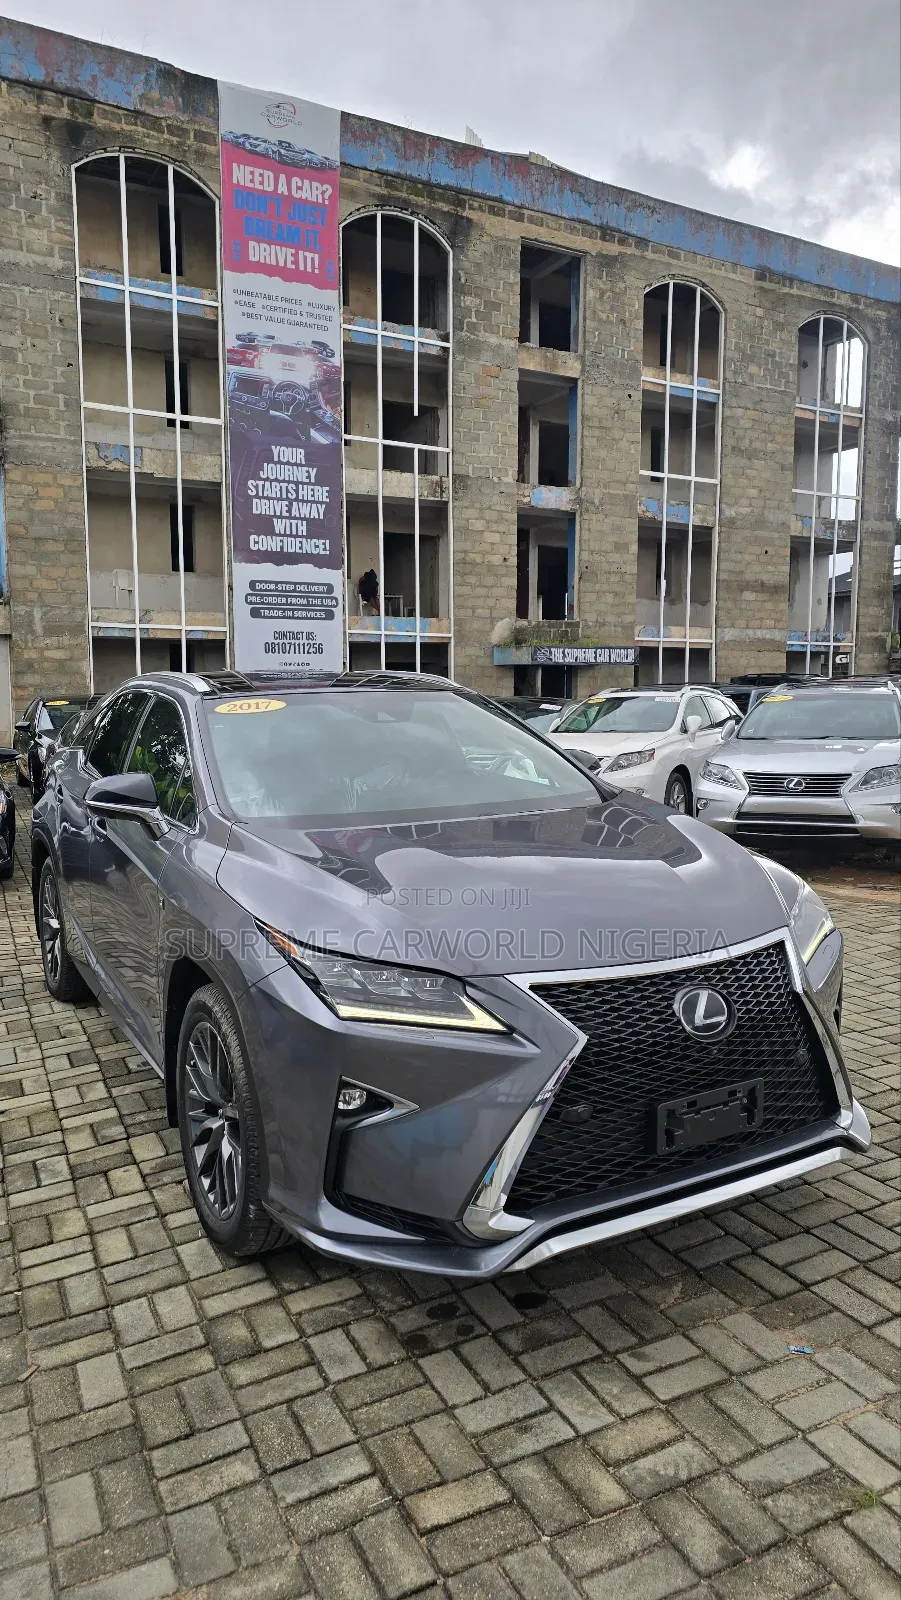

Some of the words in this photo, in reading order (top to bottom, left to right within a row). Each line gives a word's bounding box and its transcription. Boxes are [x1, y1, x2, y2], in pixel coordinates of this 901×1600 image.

[232, 163, 274, 191] NEED
[277, 174, 288, 195] A
[291, 177, 332, 204] CAR?
[234, 188, 283, 217] DON'T
[287, 202, 327, 226] JUST
[243, 216, 301, 246] DREAM
[248, 241, 295, 269] DRIVE
[299, 251, 319, 273] IT!
[239, 300, 256, 309] EASE
[266, 305, 298, 316] CERTIFIED
[306, 312, 332, 322] TRUSTED
[281, 297, 302, 306] PRICES
[312, 302, 335, 312] LUXURY
[247, 312, 262, 320] BEST
[264, 315, 286, 325] VALUE
[287, 319, 328, 331] GUARANTEED
[271, 446, 305, 464] YOUR
[260, 463, 317, 483] JOURNEY
[248, 480, 296, 499] STARTS
[299, 485, 329, 502] HERE
[253, 499, 289, 516] DRIVE
[292, 502, 325, 519] AWAY
[273, 518, 306, 535] WITH
[250, 535, 329, 554] CONFIDENCE!
[274, 631, 304, 640] CONTACT
[306, 632, 316, 641] US:
[264, 642, 323, 654] 08107111256
[551, 648, 563, 662] THE
[565, 649, 596, 662] SUPREME
[597, 649, 609, 662] CAR
[611, 649, 635, 662] WORLD!
[227, 702, 271, 712] 2017
